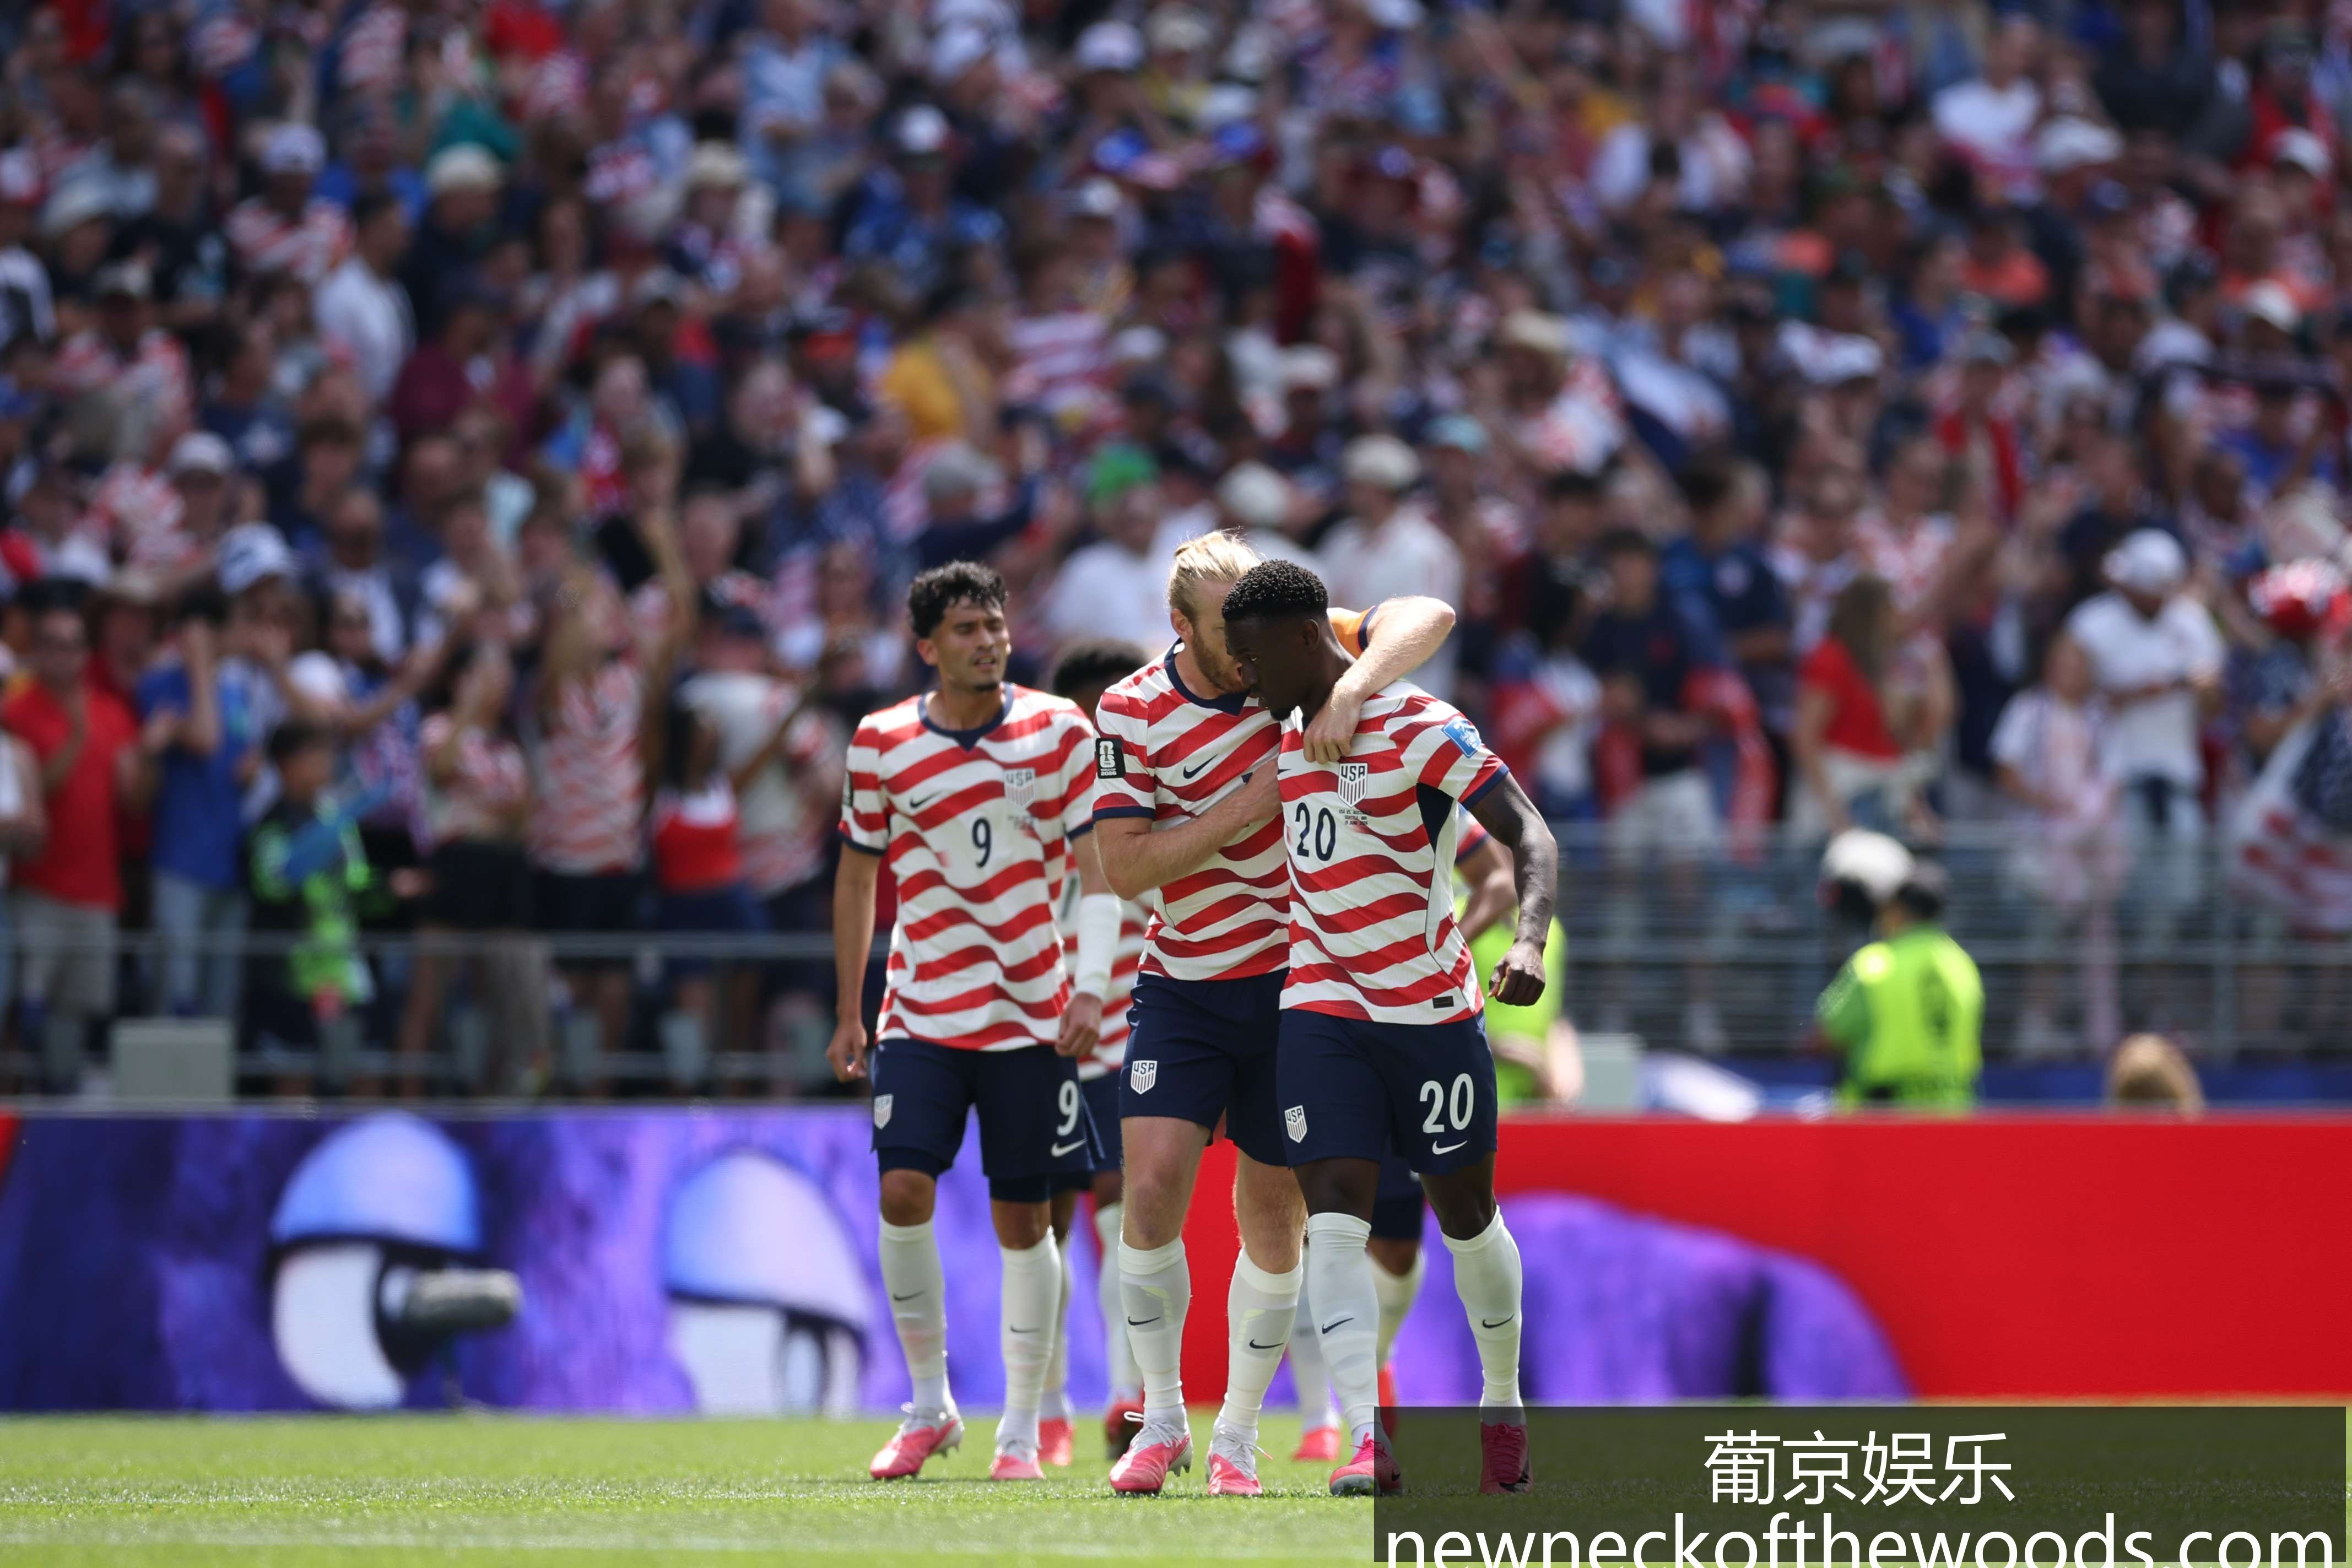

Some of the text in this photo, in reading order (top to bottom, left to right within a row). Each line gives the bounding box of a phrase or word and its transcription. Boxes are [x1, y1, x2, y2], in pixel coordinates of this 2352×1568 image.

[1006, 771, 1032, 787] USA
[1341, 765, 1365, 782] USA
[972, 818, 991, 868] 9
[1295, 802, 1336, 861] 20
[1134, 1062, 1155, 1074] USA
[1057, 1079, 1079, 1136] 9
[1286, 1107, 1302, 1123] USA
[1419, 1073, 1474, 1133] 20
